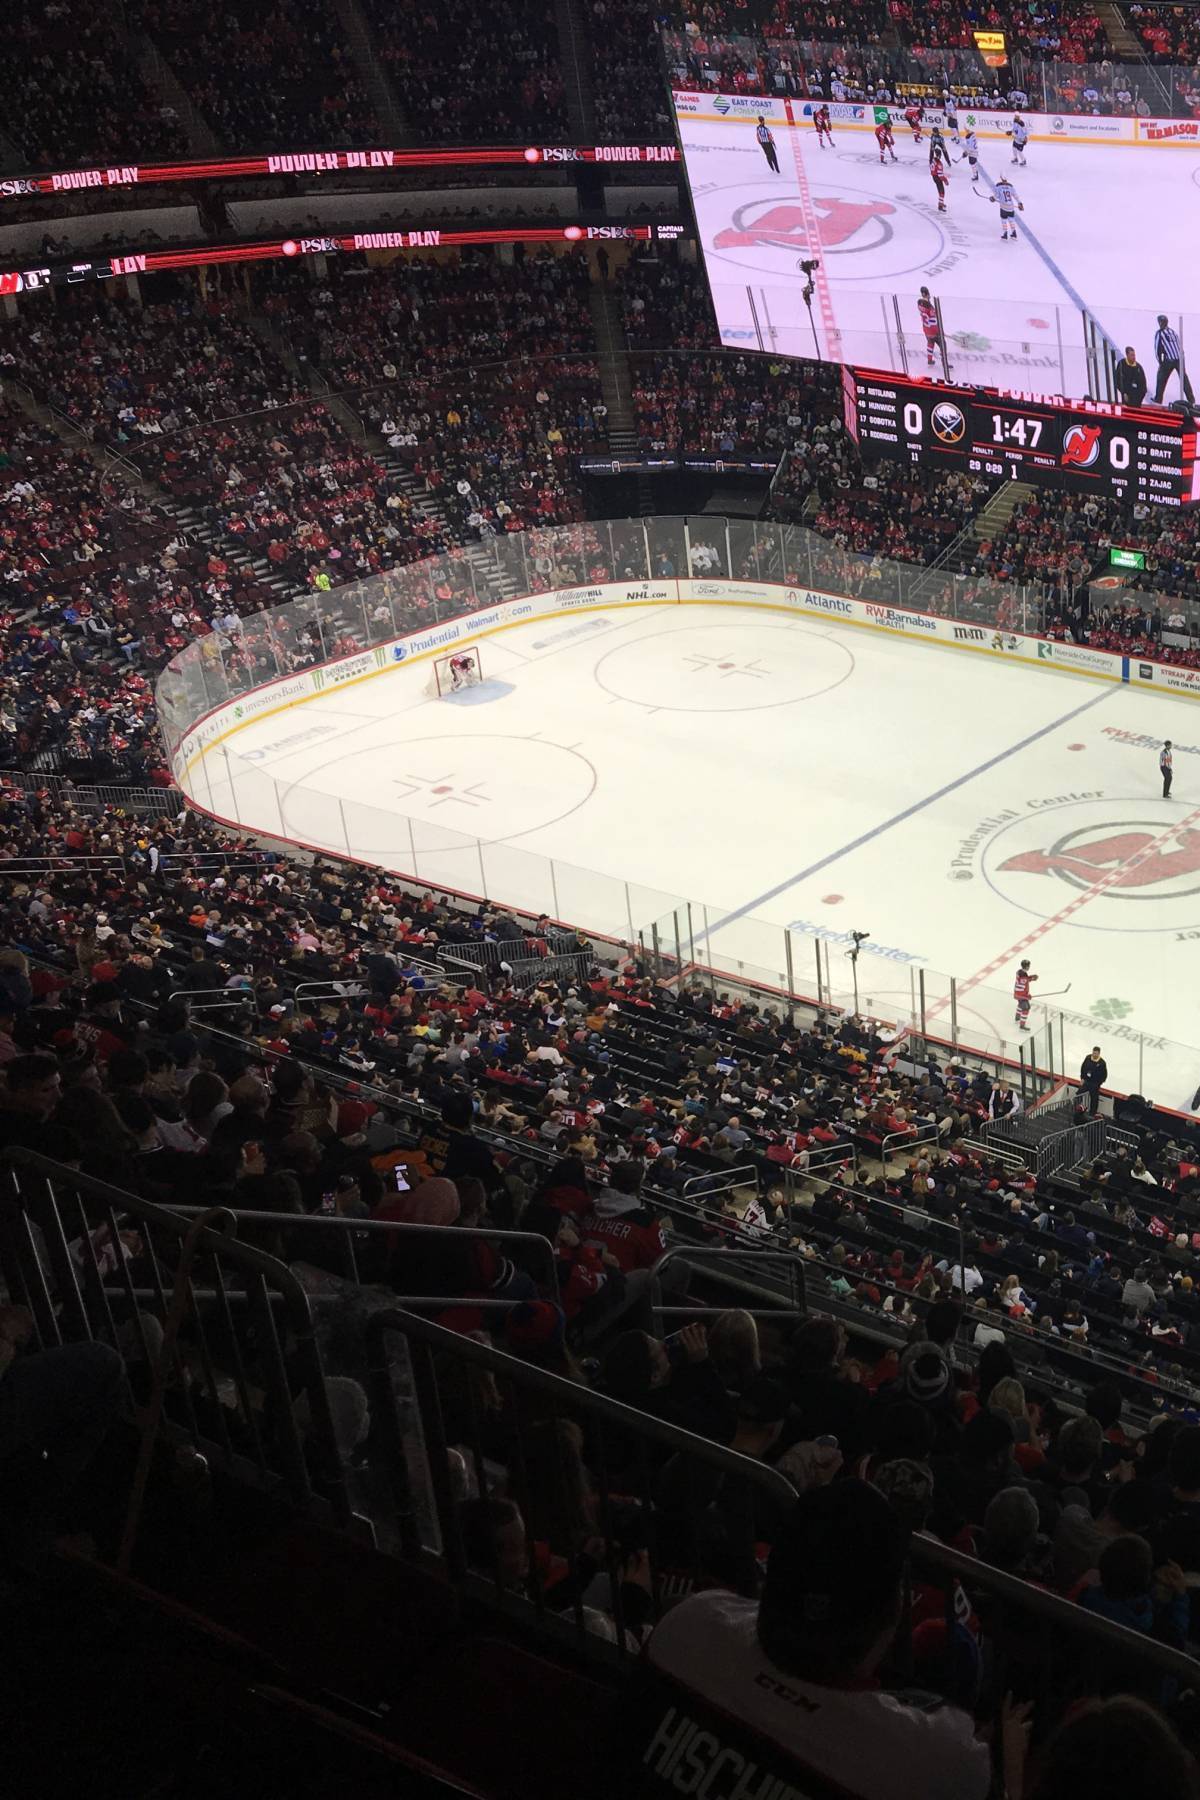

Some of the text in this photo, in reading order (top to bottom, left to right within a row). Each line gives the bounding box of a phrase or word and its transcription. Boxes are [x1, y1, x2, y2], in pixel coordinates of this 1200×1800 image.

[731, 98, 773, 109] EAST COAST
[594, 146, 641, 162] POWER
[646, 146, 677, 162] PLAY
[52, 167, 139, 191] POWER PLAY
[657, 225, 684, 233] CAPITALS
[657, 232, 678, 240] DUCKS
[354, 233, 402, 250] POWER
[409, 230, 441, 246] PLAY
[868, 402, 897, 414] HUNWICK
[859, 414, 897, 428] 17 SOBOTKA
[903, 402, 924, 436] 0
[860, 429, 868, 438] 71
[991, 413, 1043, 448] 1:47
[1150, 432, 1183, 446] SEVERSON
[906, 442, 923, 451] SHOTS
[972, 445, 994, 456] PENALTY
[1109, 435, 1130, 470] 0
[1150, 448, 1172, 459] BRATT
[911, 452, 919, 462] 11
[1005, 451, 1023, 461] PERIOD
[1033, 456, 1056, 467] PENALTY
[1010, 463, 1018, 480] 1
[1149, 463, 1183, 477] JOHANSSON
[1111, 477, 1128, 487] SHOTS
[1149, 478, 1172, 490] ZAJAC
[1137, 491, 1181, 506] 21 PALMIERI
[804, 592, 853, 614] Atlantic
[466, 611, 500, 631] Walmart
[875, 617, 905, 631] HEALTH
[410, 625, 460, 654] Prudential
[1160, 668, 1186, 681] STREAM
[1167, 679, 1180, 688] LIVE
[1180, 681, 1189, 689] ON
[1026, 790, 1105, 810] Center
[951, 808, 1021, 869] Prudential
[754, 1671, 821, 1714] CCM
